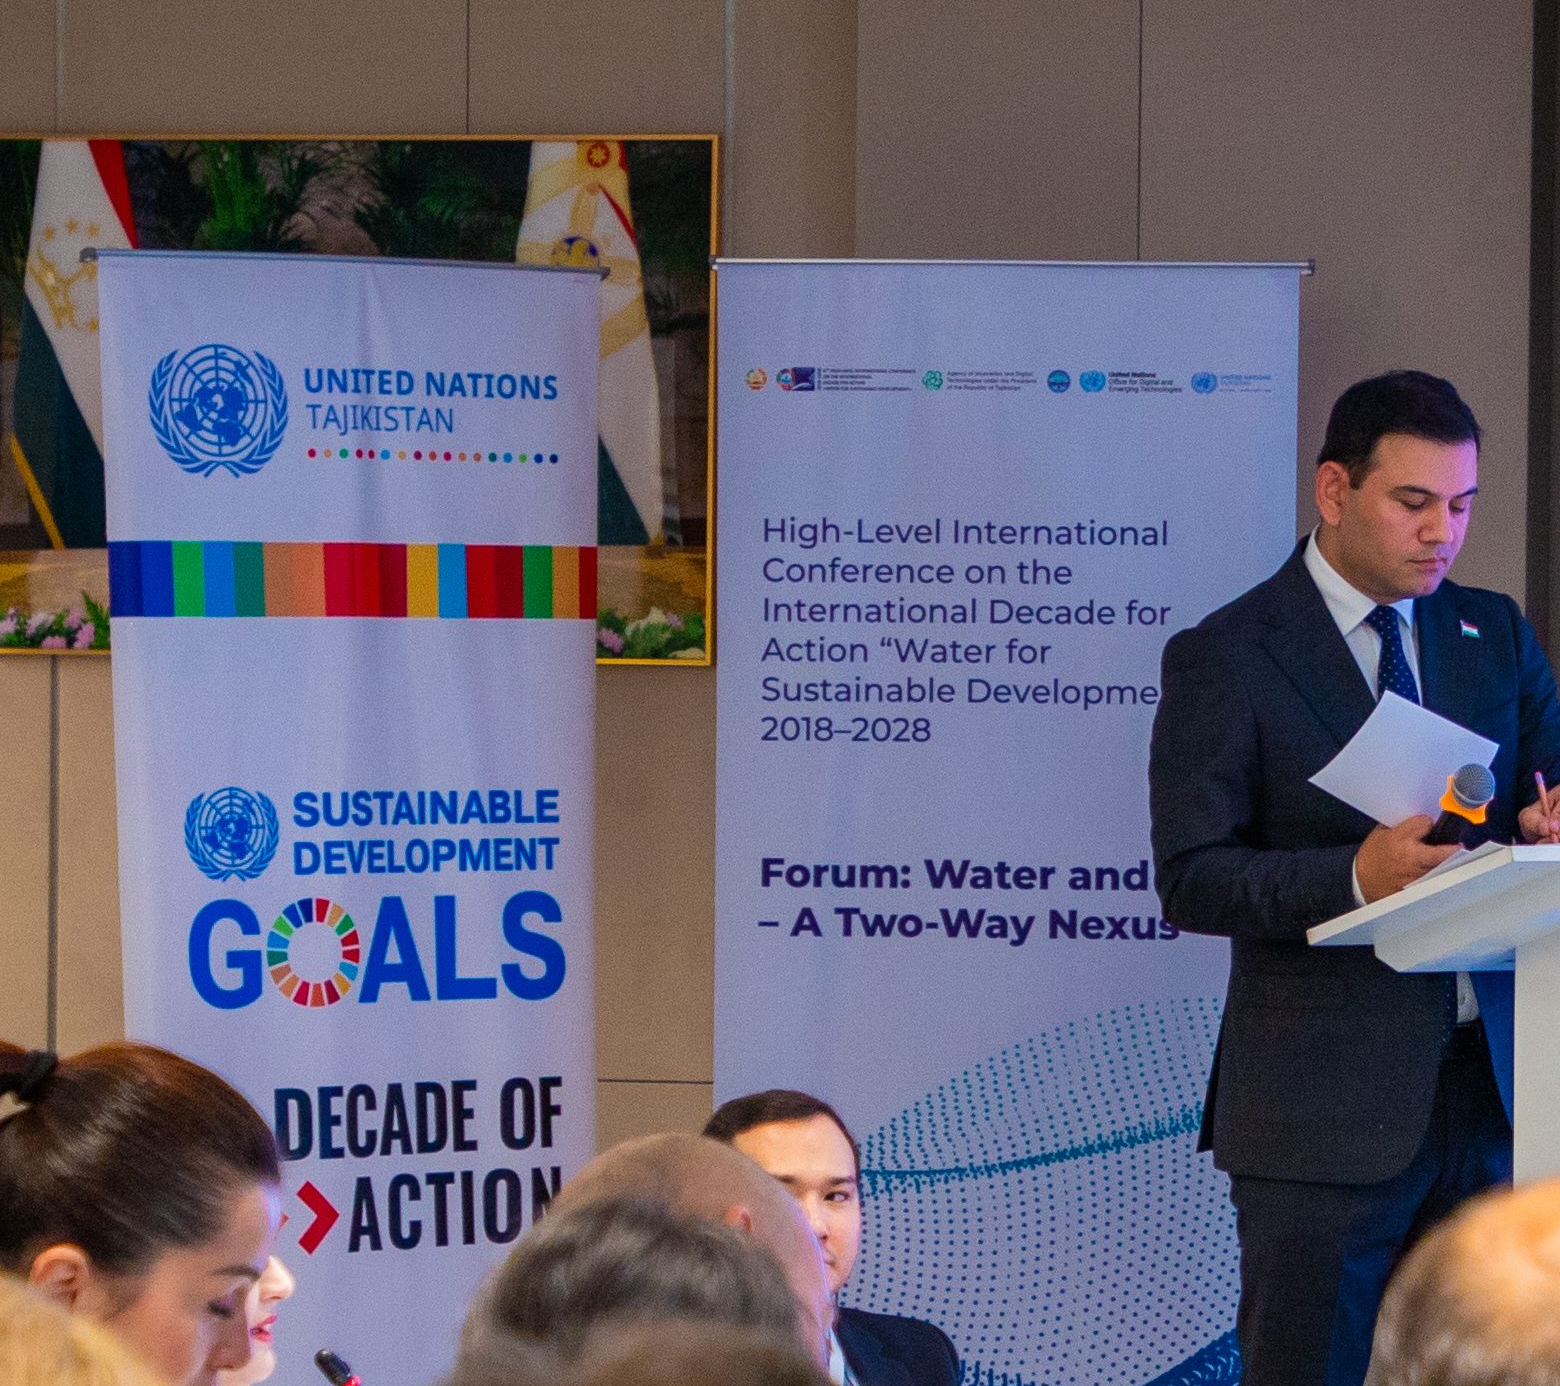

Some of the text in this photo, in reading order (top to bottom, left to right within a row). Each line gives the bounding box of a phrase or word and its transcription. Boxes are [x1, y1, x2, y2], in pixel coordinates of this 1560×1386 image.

[304, 368, 558, 400] UNITED NATIONS
[306, 404, 454, 436] TAJIKISTAN
[764, 516, 1167, 549] High-Level International
[763, 557, 1072, 585] Conference on the
[764, 597, 1171, 625] International Decade for
[761, 636, 1052, 664] Action “Water for
[762, 676, 1160, 710] Sustainable Developme
[293, 789, 560, 827] SUSTAINABLE
[294, 837, 560, 875] DEVELOPMENT
[762, 858, 1148, 891] Forum: Water and
[790, 907, 823, 937] A
[834, 907, 1035, 947] Two-Way
[1049, 908, 1179, 941] Nexus
[275, 1076, 562, 1162] DECADE OF
